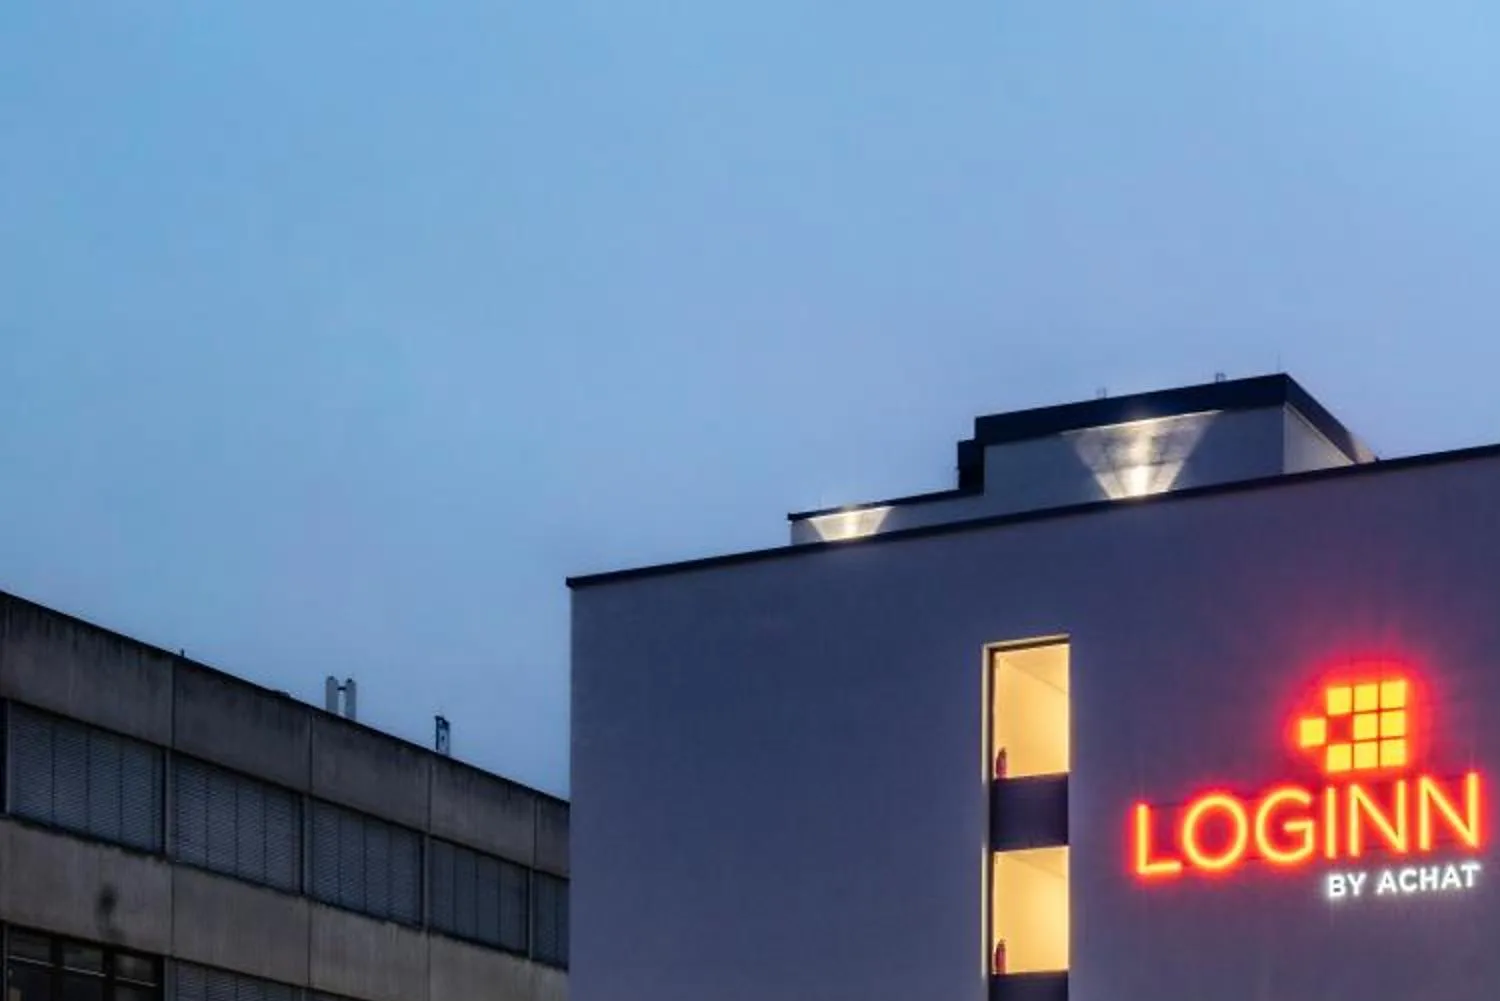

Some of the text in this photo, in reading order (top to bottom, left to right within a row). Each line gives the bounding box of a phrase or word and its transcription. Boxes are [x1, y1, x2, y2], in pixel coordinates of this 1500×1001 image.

[1135, 771, 1481, 875] LOGINN
[1328, 863, 1481, 898] BY ACHAT
